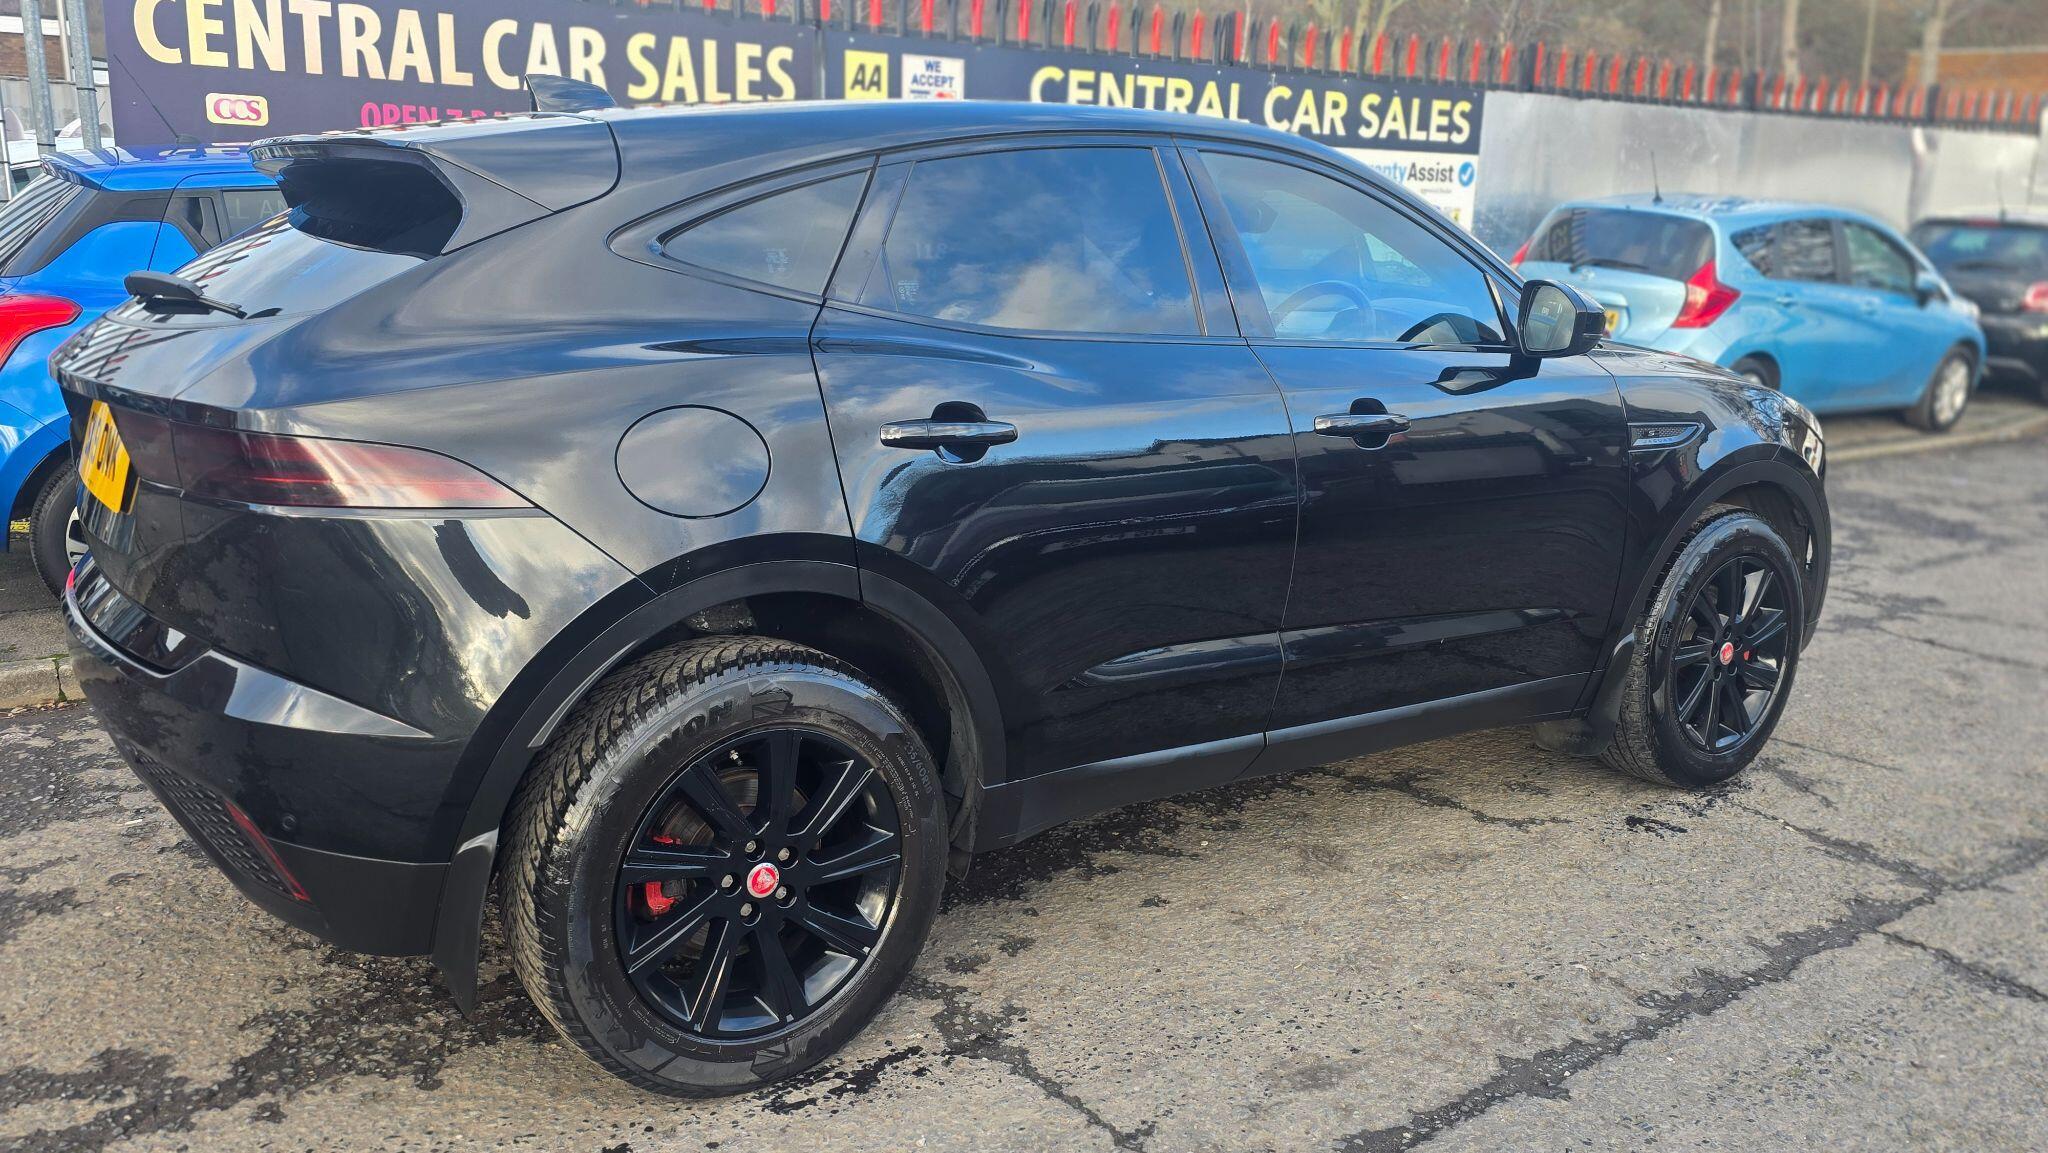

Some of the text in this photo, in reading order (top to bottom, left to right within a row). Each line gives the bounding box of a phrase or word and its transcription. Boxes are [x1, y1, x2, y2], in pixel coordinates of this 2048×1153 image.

[133, 0, 796, 103] CENTRAL CAR SALES
[850, 62, 882, 92] AA
[924, 60, 942, 73] WE
[911, 74, 955, 88] ACCEPT
[360, 101, 438, 128] OPEN
[1029, 65, 1472, 145] CENTRAL CAR SALES
